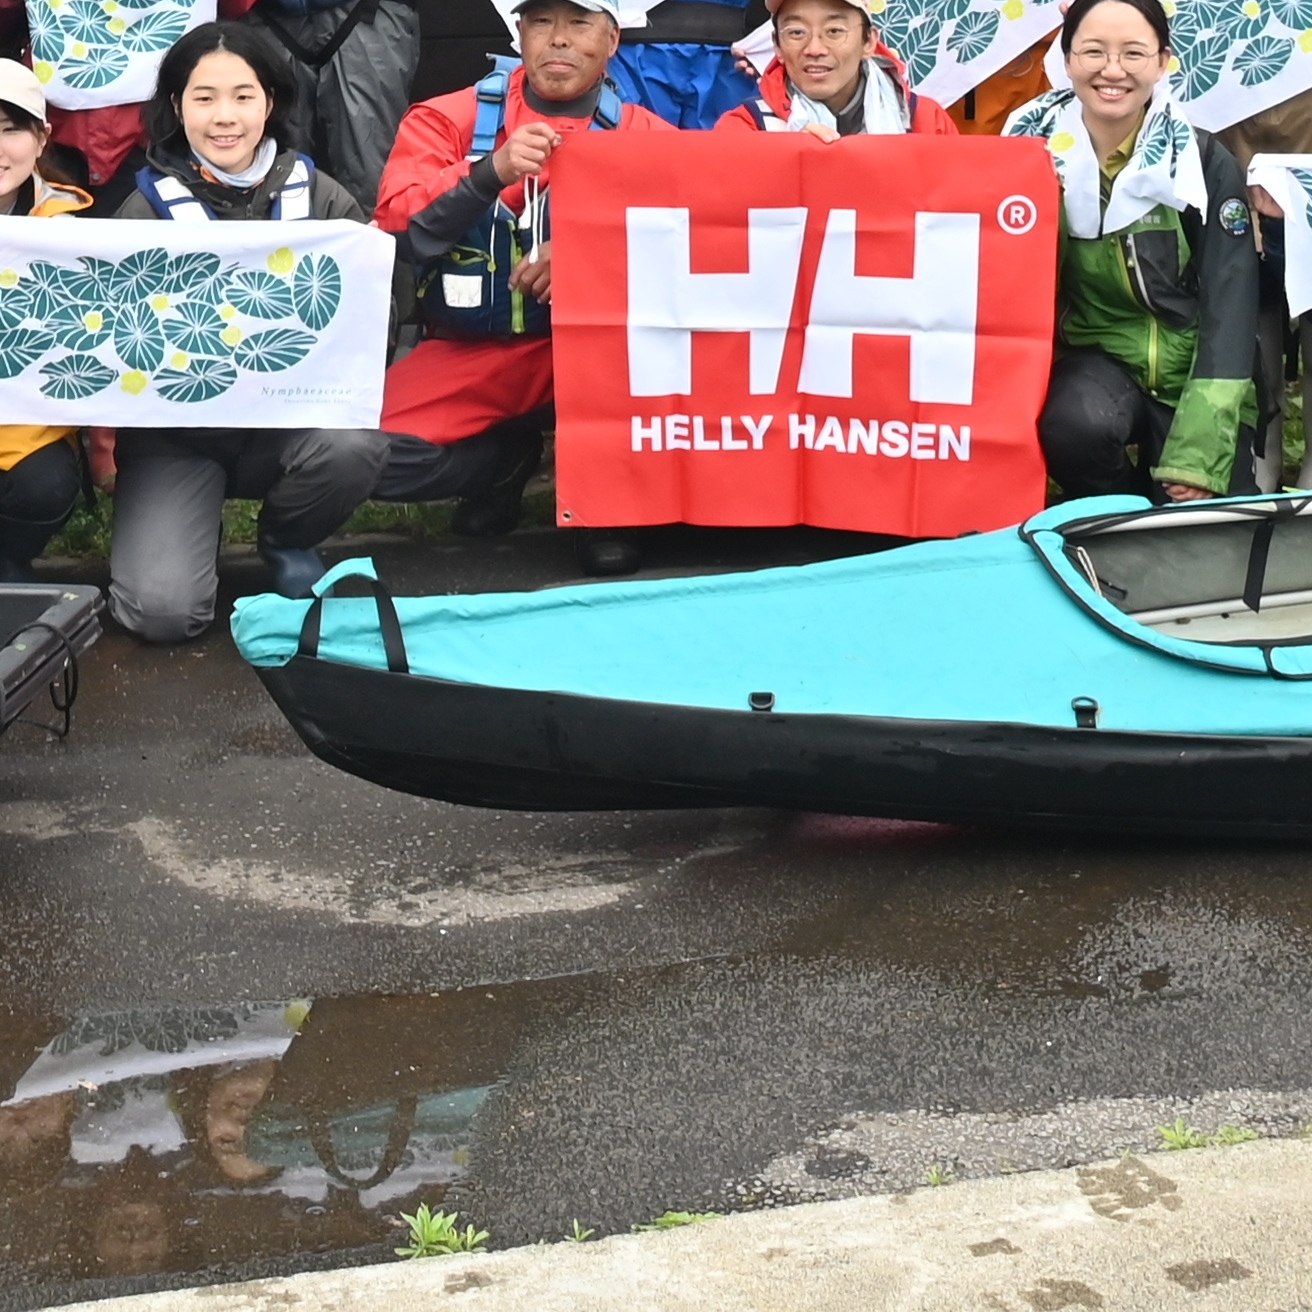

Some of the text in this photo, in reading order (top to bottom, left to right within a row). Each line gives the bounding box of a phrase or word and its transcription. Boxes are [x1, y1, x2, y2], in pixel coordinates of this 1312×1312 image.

[626, 207, 981, 406] HH
[631, 414, 971, 462] HELLY HANSEN
